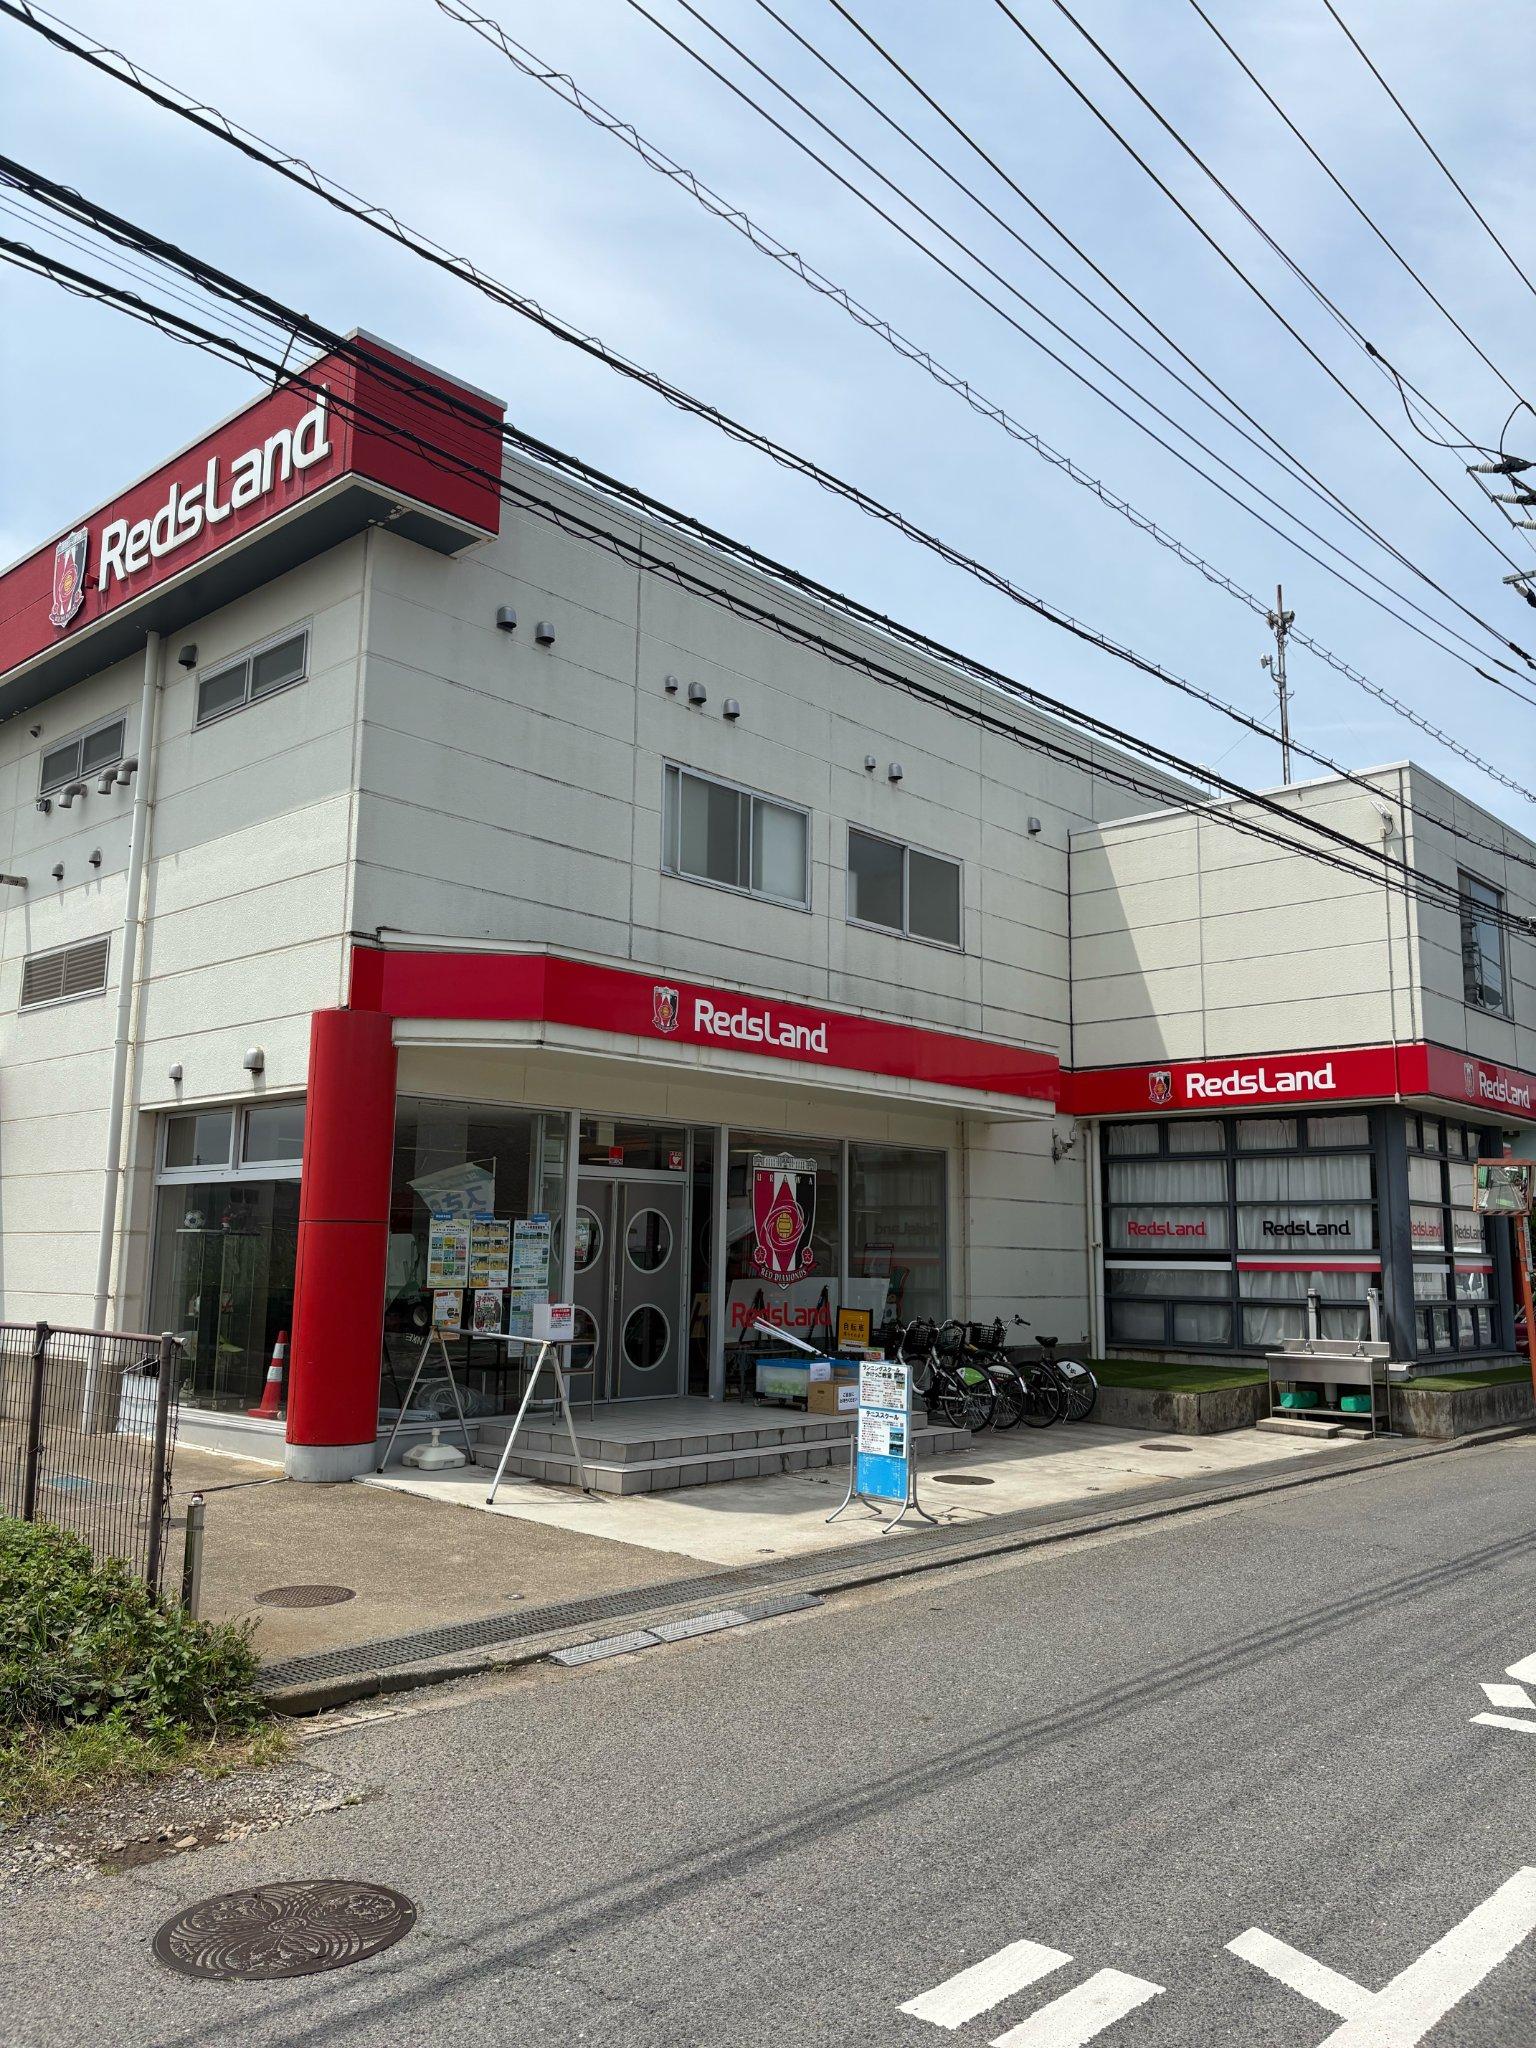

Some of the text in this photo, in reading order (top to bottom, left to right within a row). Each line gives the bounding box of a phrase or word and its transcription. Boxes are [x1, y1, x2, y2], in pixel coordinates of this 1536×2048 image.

[694, 998, 828, 1053] RedsLand
[1186, 1062, 1337, 1099] RedsLand
[1127, 1221, 1207, 1236] RedsLand
[1263, 1220, 1351, 1236] RedsLand
